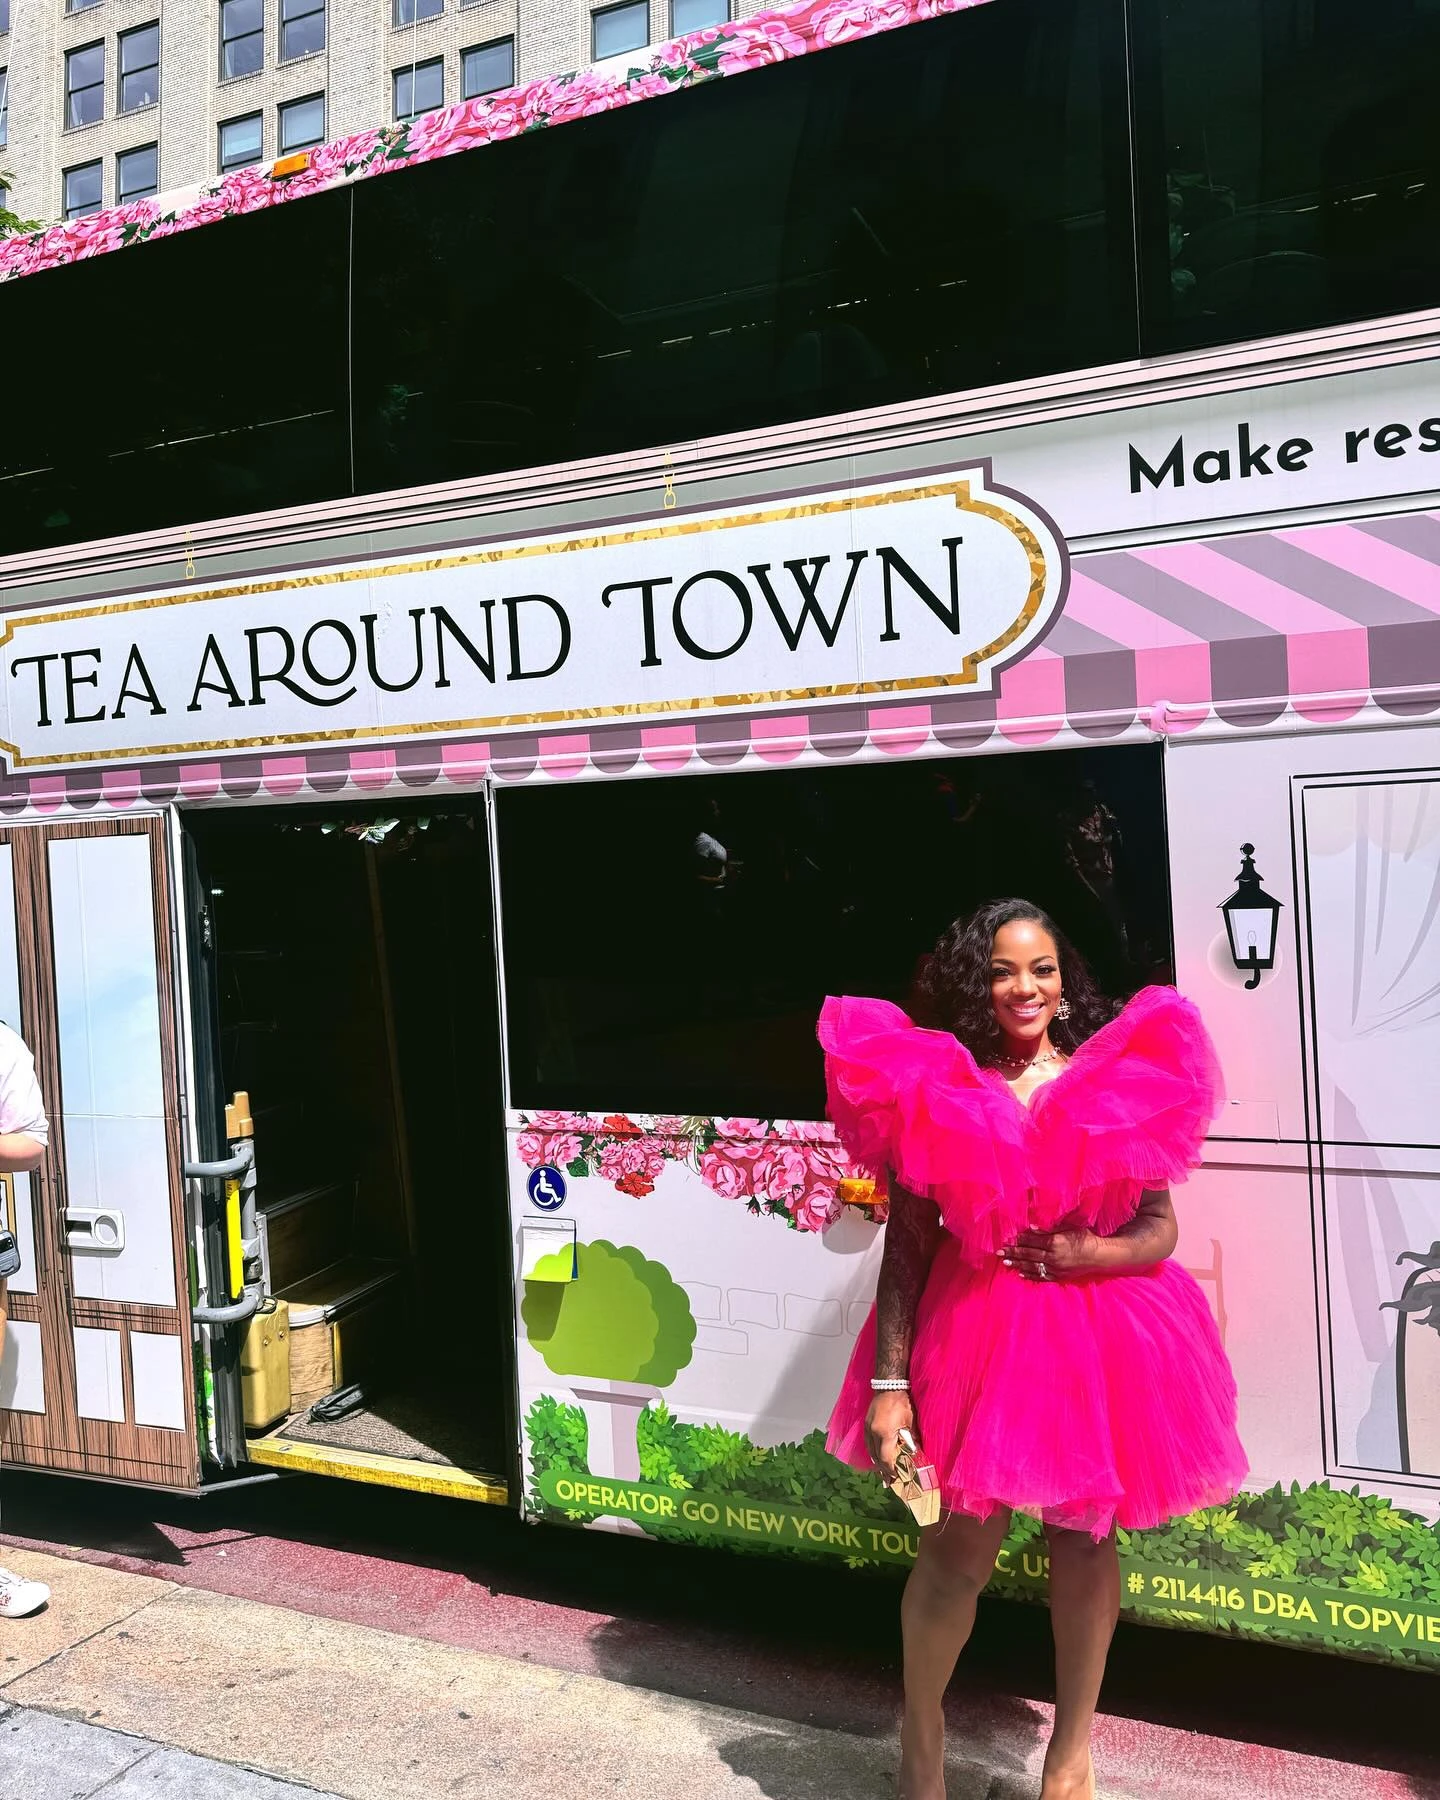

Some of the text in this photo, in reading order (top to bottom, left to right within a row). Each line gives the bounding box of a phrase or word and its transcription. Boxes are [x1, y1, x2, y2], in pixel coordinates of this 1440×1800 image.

[1128, 422, 1314, 494] Make
[10, 536, 963, 728] TEA AROUND TOWN
[555, 1479, 678, 1518] OPERATOR:
[681, 1500, 720, 1526] GO
[726, 1504, 786, 1536] NEW
[791, 1515, 862, 1549] YORK
[1127, 1572, 1145, 1595] #
[1151, 1575, 1246, 1611] 2114416
[1252, 1588, 1319, 1624] DBA
[1324, 1599, 1440, 1643] TOPVIE
